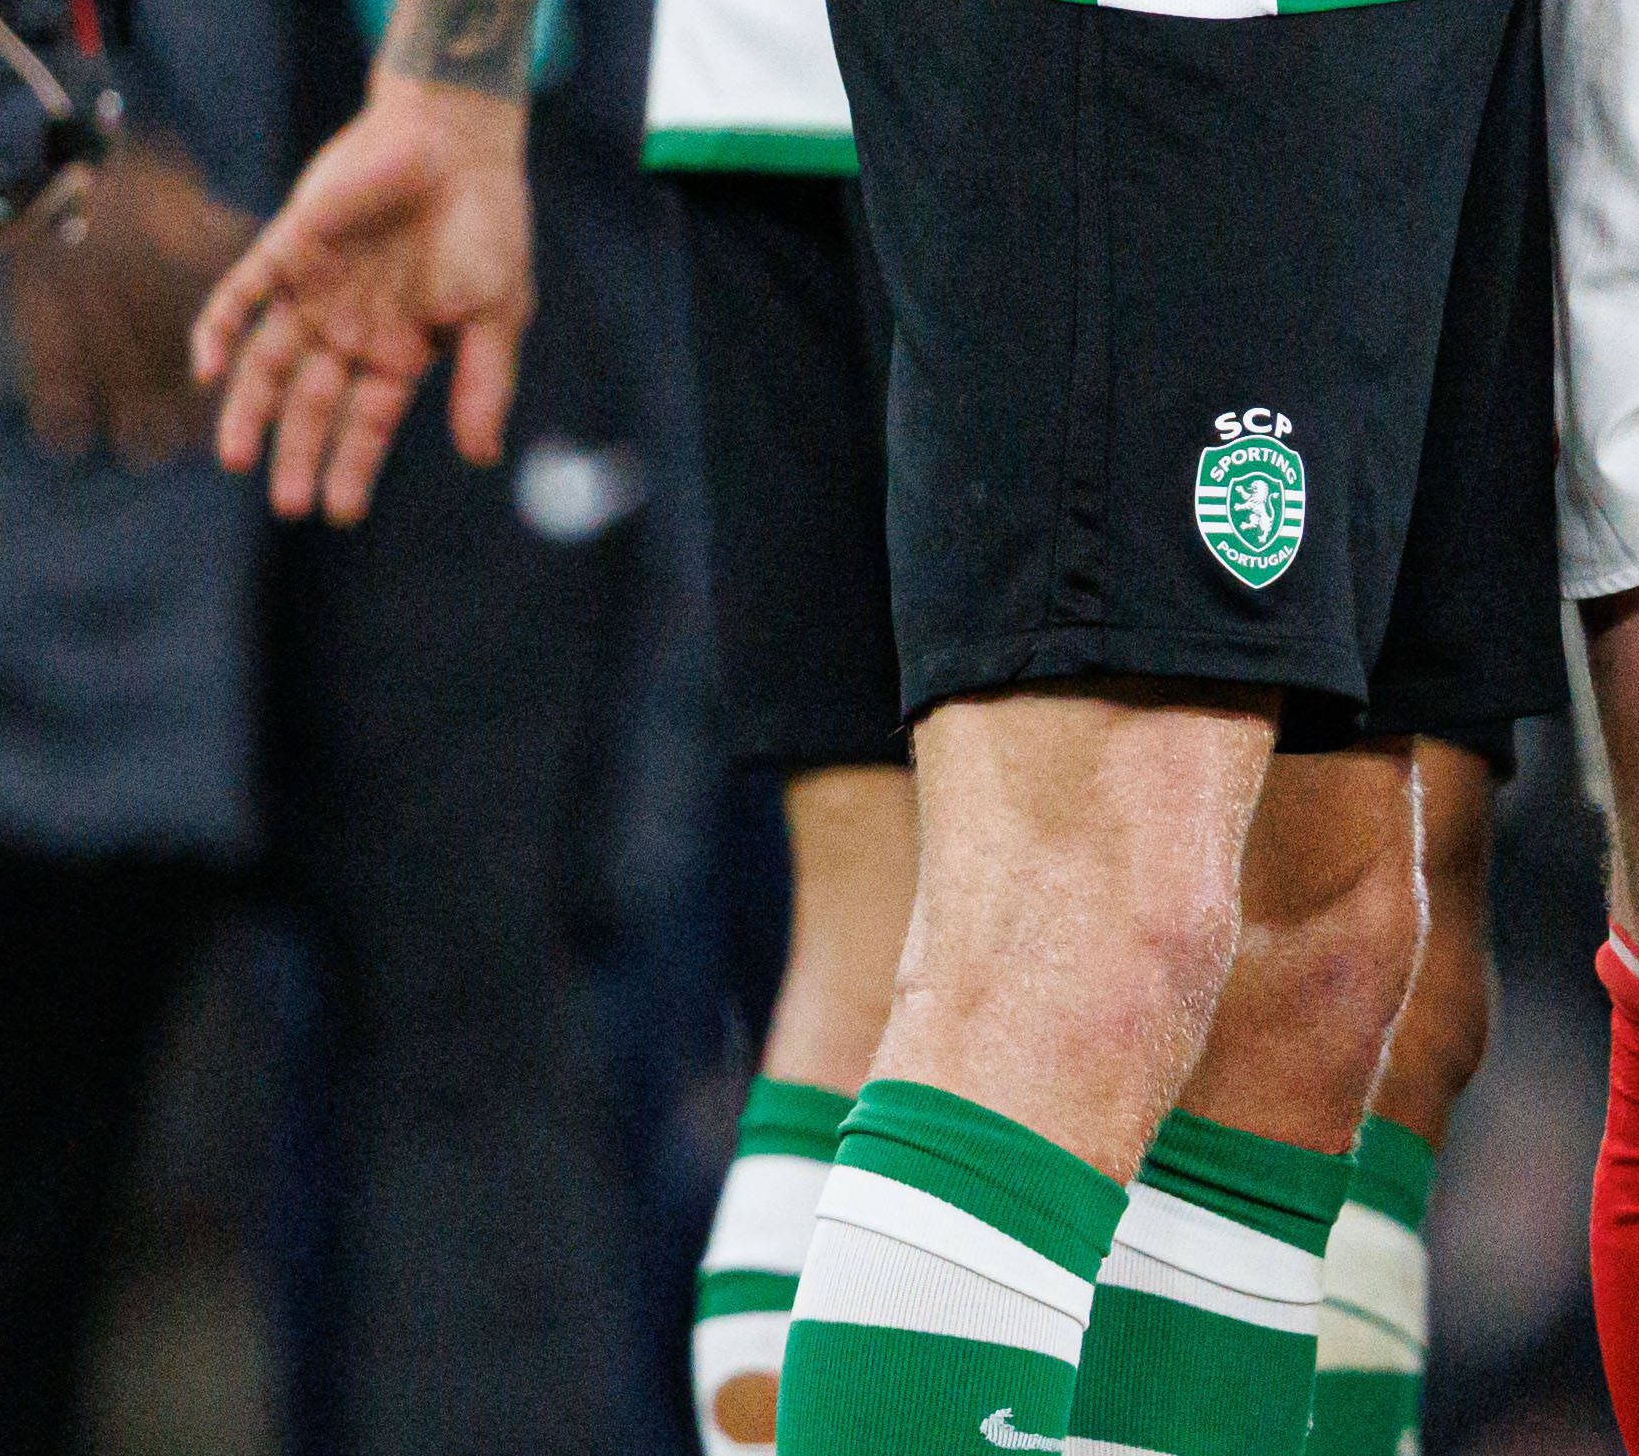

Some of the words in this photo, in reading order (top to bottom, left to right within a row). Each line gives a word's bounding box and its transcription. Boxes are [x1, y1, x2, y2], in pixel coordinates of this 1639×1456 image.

[1214, 407, 1293, 440] SCP
[1209, 446, 1298, 486] SPORTING
[1216, 539, 1294, 569] PORTUGAL
